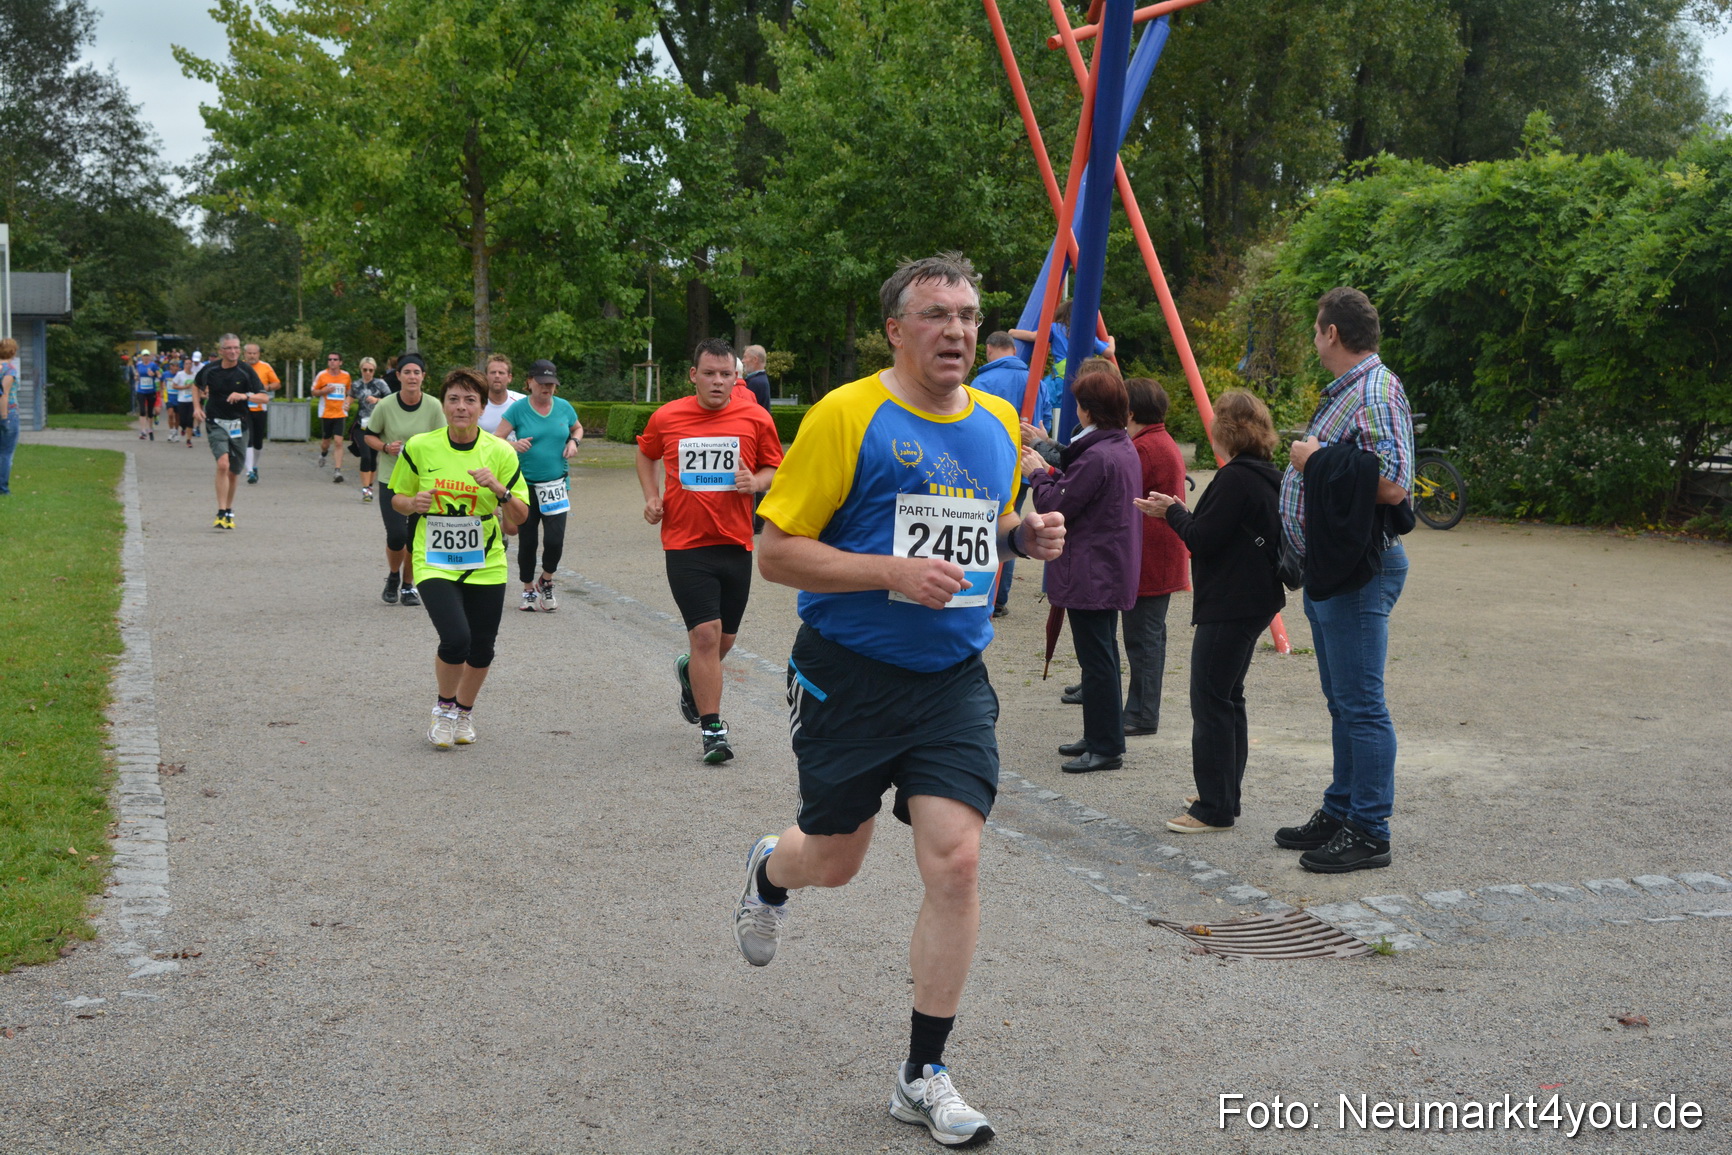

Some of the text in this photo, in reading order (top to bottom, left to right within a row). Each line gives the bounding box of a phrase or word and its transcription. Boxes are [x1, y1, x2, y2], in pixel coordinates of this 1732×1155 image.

[686, 450, 734, 470] 2178
[434, 478, 479, 493] Müller
[899, 505, 984, 520] PARTL Neumarkt
[432, 529, 478, 550] 2630
[907, 522, 989, 566] 2456
[448, 554, 462, 562] Rita
